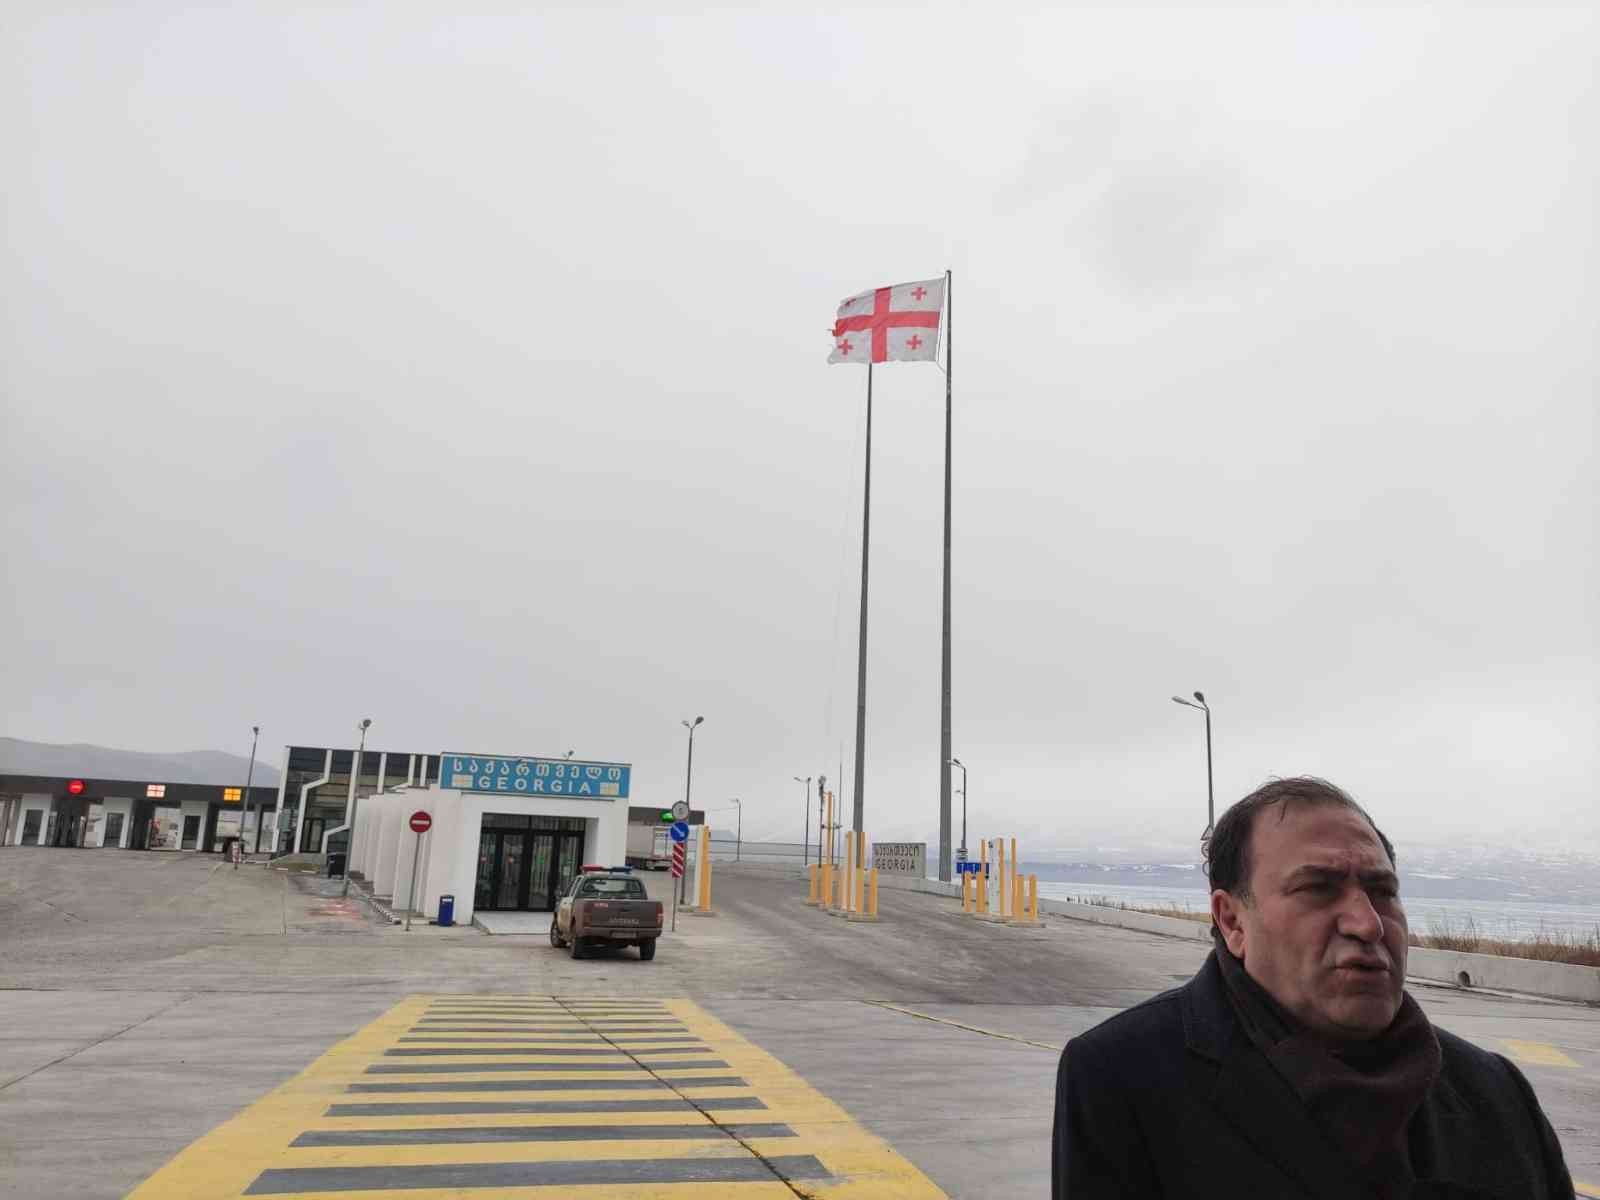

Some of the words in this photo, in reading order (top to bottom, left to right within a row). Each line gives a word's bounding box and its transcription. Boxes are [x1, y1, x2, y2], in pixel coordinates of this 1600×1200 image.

[453, 758, 621, 782] საქართველო
[478, 775, 592, 794] GEORGIA
[875, 858, 916, 872] GEORGIA
